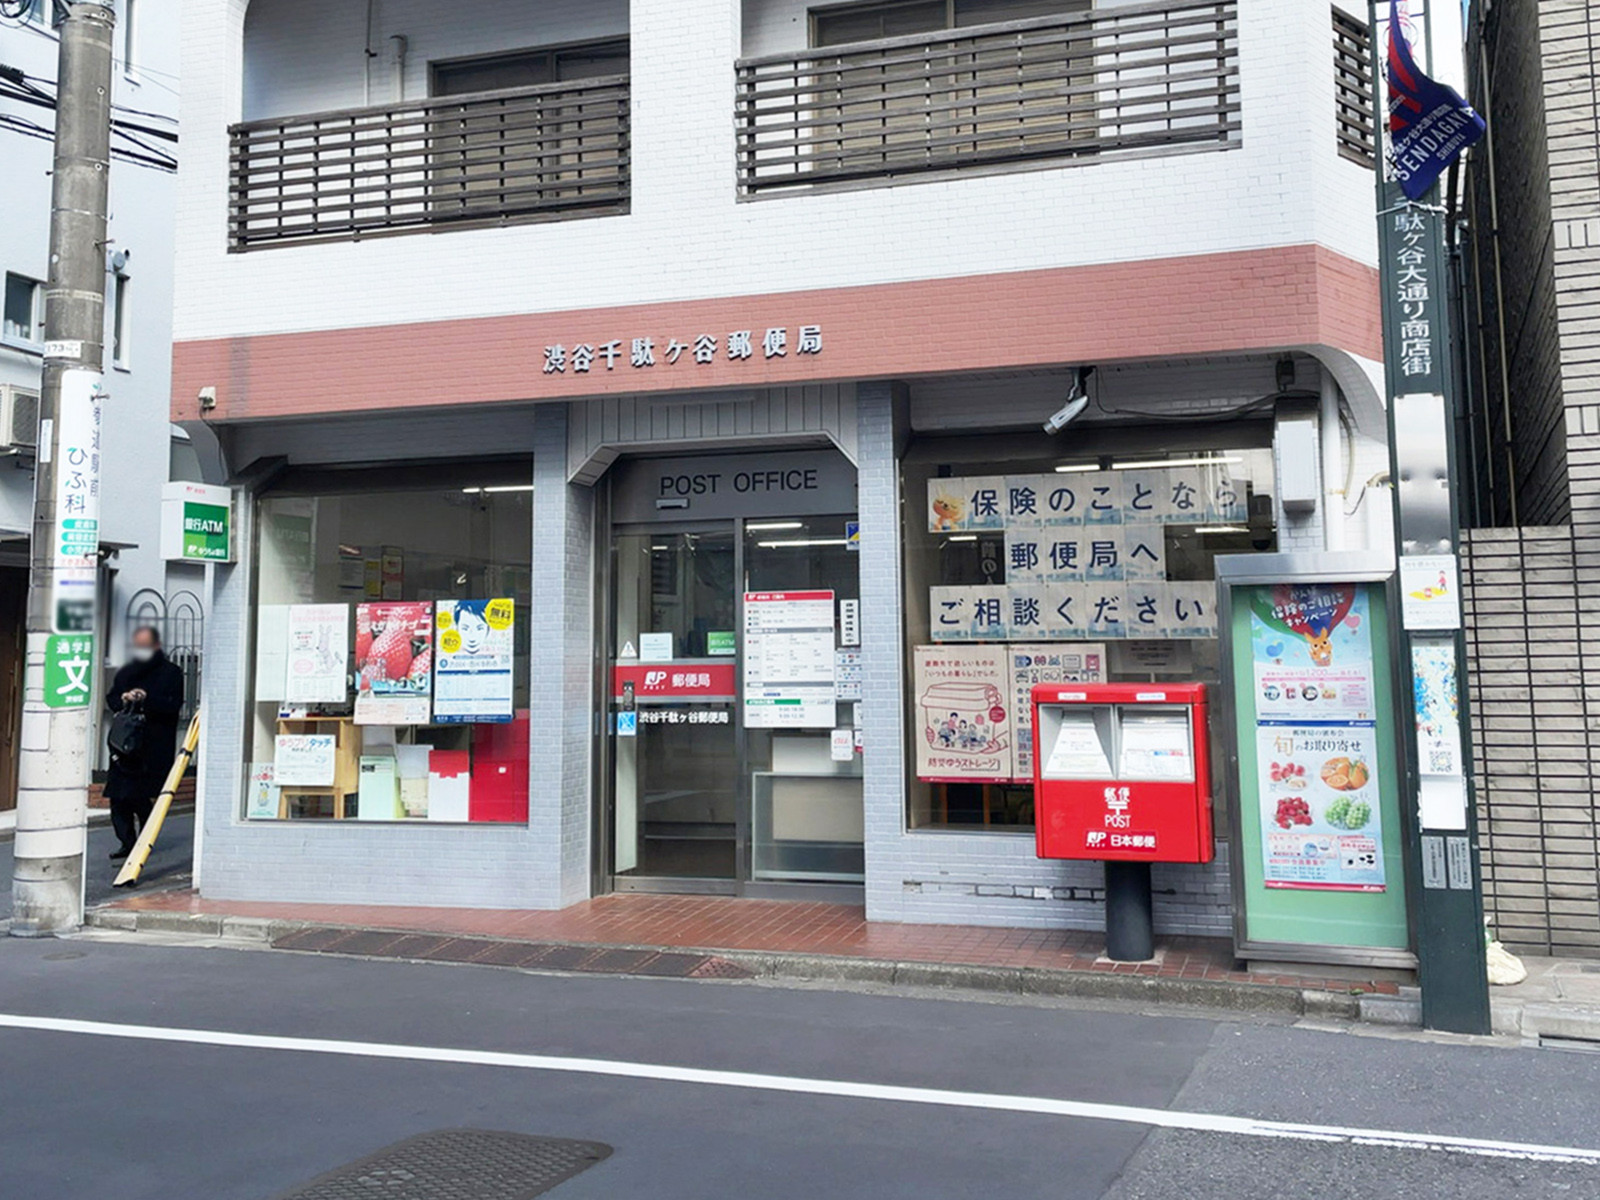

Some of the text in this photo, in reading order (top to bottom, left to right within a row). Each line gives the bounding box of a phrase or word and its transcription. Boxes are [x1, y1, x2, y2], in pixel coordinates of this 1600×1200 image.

[1395, 106, 1474, 181] SENDAGAYA
[1436, 133, 1466, 161] SHIBUYA
[542, 325, 823, 373] 渋谷千駄ケ谷郵便局
[65, 447, 88, 514] ひふ科
[660, 469, 818, 496] POST OFFICE
[970, 480, 1238, 517] 保険のことなら
[1010, 540, 1159, 571] 郵便局へ
[940, 596, 1203, 626] ご相談ください
[1285, 608, 1338, 628] キャンペーン
[56, 655, 90, 695] 文
[672, 673, 711, 688] 郵便局
[1104, 786, 1131, 803] 郵便
[1104, 815, 1131, 828] POST
[1111, 834, 1156, 848] 日本郵便
